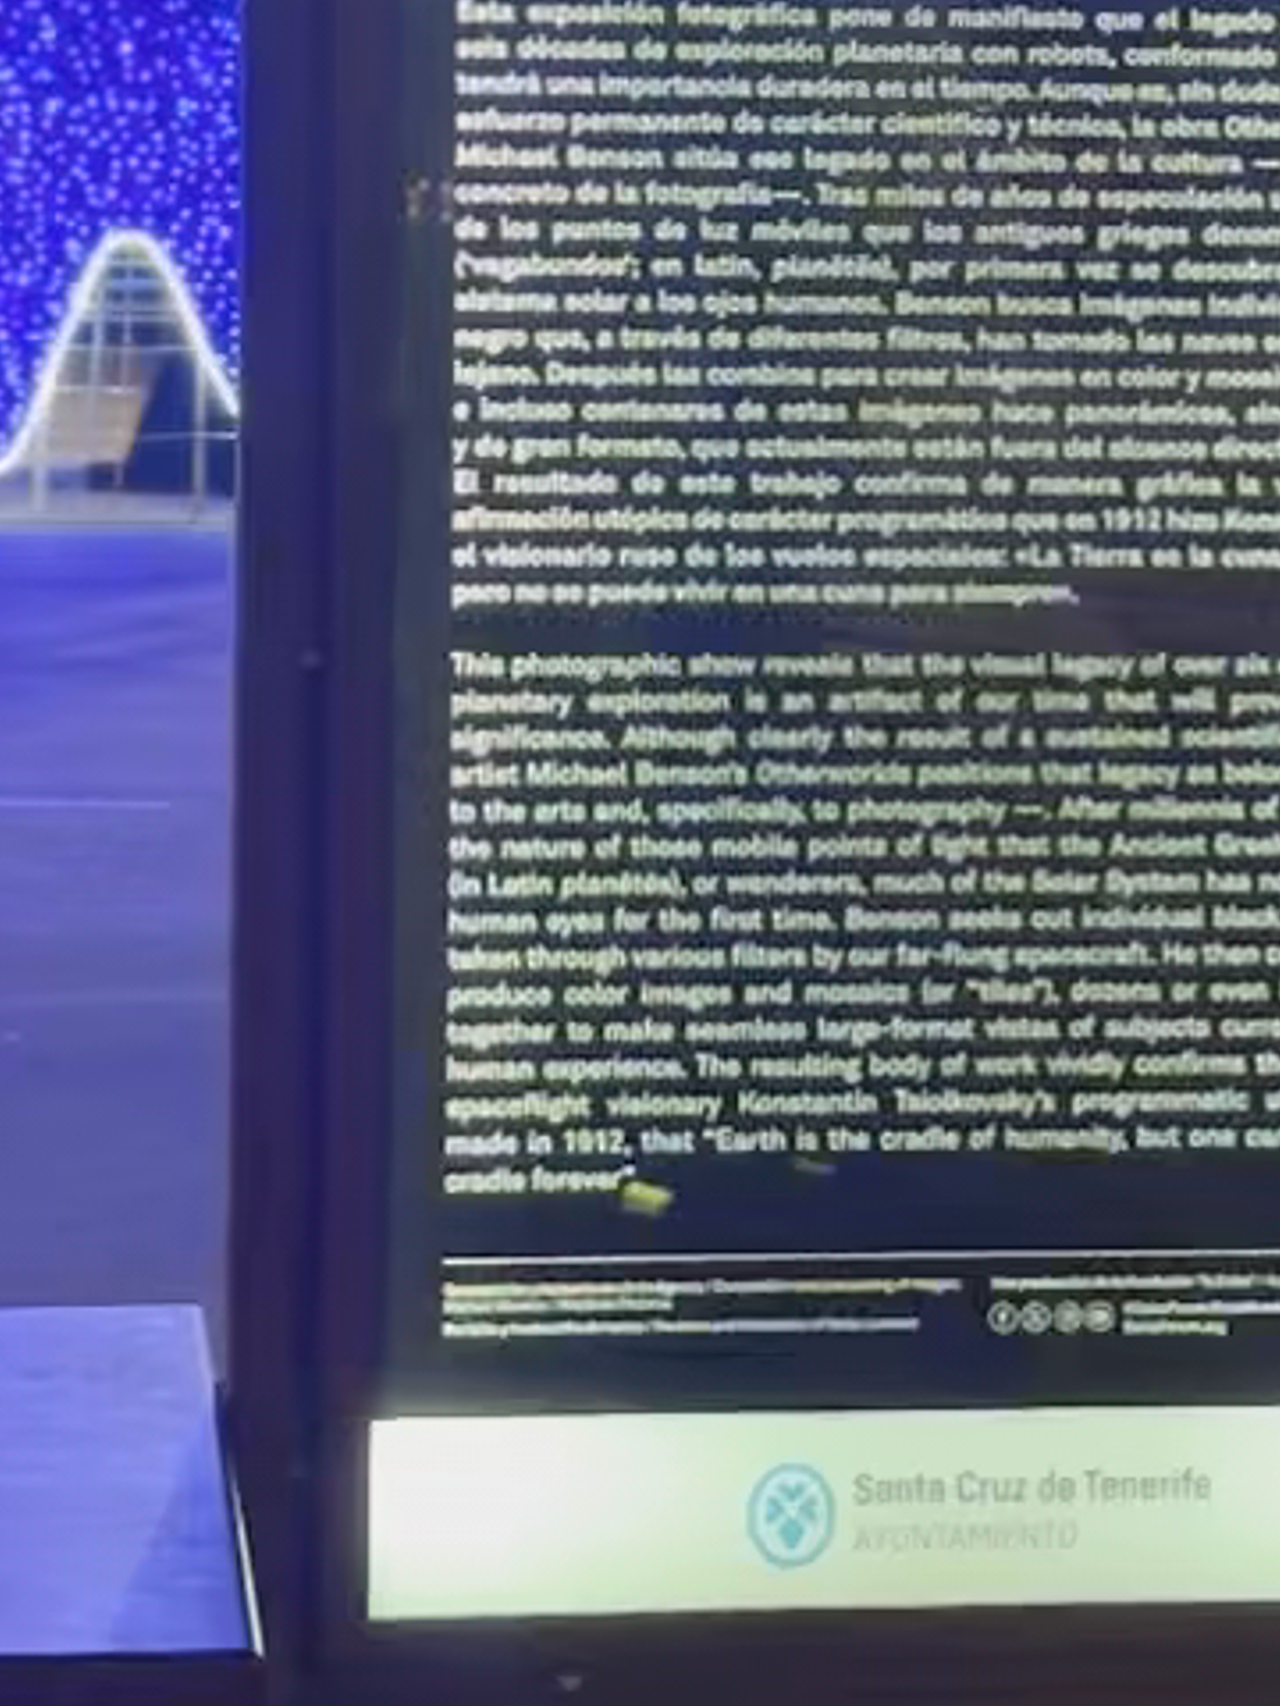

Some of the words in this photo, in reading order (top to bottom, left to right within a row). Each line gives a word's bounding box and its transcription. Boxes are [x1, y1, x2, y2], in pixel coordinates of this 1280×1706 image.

[675, 4, 817, 31] fotográfica
[828, 9, 892, 32] pone
[903, 6, 936, 28] de
[1094, 12, 1143, 34] que
[1153, 8, 1179, 30] el
[674, 40, 824, 67] exploración
[832, 41, 964, 68] planetaria
[970, 46, 1019, 64] con
[1026, 43, 1117, 69] robots,
[1122, 44, 1277, 66] conformado
[544, 79, 596, 97] una
[910, 78, 934, 99] el
[880, 113, 1001, 136] científico
[1005, 118, 1022, 140] y
[453, 146, 559, 168] Michael
[565, 147, 664, 169] Benson
[802, 149, 890, 175] legado
[613, 184, 640, 205] la
[498, 219, 540, 240] los
[550, 219, 642, 246] puntos
[750, 220, 851, 242] móviles
[862, 225, 911, 247] que
[649, 260, 683, 277] en
[908, 261, 952, 283] por
[964, 258, 1065, 284] primera
[562, 292, 629, 313] solar
[701, 292, 757, 318] ojos
[706, 328, 741, 350] de
[1116, 366, 1181, 388] color
[776, 401, 848, 423] estas
[989, 438, 1057, 459] fuera
[630, 473, 665, 494] de
[679, 473, 736, 495] este
[853, 474, 967, 495] confirma
[1102, 510, 1161, 532] 1912
[481, 545, 613, 567] visionario
[723, 546, 765, 567] los
[1070, 546, 1144, 568] Tierra
[450, 654, 505, 675] This
[509, 654, 681, 680] photographic
[861, 654, 913, 676] that
[921, 654, 965, 676] the
[1052, 654, 1133, 680] legacy
[1139, 654, 1166, 676] of
[449, 690, 573, 716] planetary
[586, 690, 731, 716] exploration
[743, 690, 767, 712] is
[781, 694, 814, 712] an
[1170, 691, 1216, 712] will
[620, 727, 736, 753] Although
[746, 727, 833, 753] clearly
[842, 727, 887, 748] the
[449, 763, 520, 785] artist
[525, 763, 628, 785] Michael
[1040, 763, 1092, 784] that
[481, 800, 527, 821] the
[532, 800, 587, 821] arts
[846, 799, 1006, 825] photography
[1058, 799, 1121, 821] After
[447, 836, 493, 858] the
[499, 836, 586, 858] nature
[593, 836, 622, 858] of
[710, 836, 798, 858] mobile
[806, 836, 888, 862] points
[1057, 835, 1101, 857] the
[486, 873, 554, 894] Latin
[691, 876, 719, 894] or
[872, 872, 944, 894] much
[950, 872, 977, 894] of
[1104, 872, 1200, 898] System
[1205, 872, 1252, 893] has
[446, 909, 538, 931] human
[544, 913, 605, 935] eyes
[612, 909, 649, 931] for
[657, 909, 701, 931] the
[709, 909, 763, 931] first
[771, 909, 835, 930] time.
[1029, 908, 1073, 930] out
[524, 946, 627, 972] through
[630, 945, 726, 967] various
[730, 945, 807, 967] filters
[811, 945, 843, 971] by
[847, 949, 889, 967] our
[562, 982, 629, 1004] color
[638, 982, 733, 1008] images
[743, 982, 793, 1003] and
[1170, 984, 1198, 1002] or
[565, 1020, 594, 1041] to
[602, 1019, 675, 1041] make
[445, 1056, 536, 1078] human
[541, 1056, 687, 1083] experience.
[695, 1056, 742, 1077] The
[748, 1055, 862, 1082] resulting
[868, 1055, 931, 1081] body
[974, 1054, 1037, 1076] work
[605, 1092, 722, 1119] visionary
[737, 1092, 878, 1114] Konstantin
[1070, 1090, 1250, 1117] programmatic
[443, 1131, 519, 1153] made
[525, 1131, 553, 1153] in
[563, 1130, 632, 1157] 1912,
[639, 1130, 694, 1152] that
[794, 1129, 818, 1151] is
[826, 1129, 871, 1151] the
[879, 1129, 960, 1151] cradle
[1135, 1128, 1180, 1149] but
[1187, 1131, 1237, 1149] one
[443, 1170, 530, 1192] cradle
[851, 1472, 947, 1506] Santa
[955, 1469, 1028, 1504] Cruz
[1037, 1468, 1077, 1503] de
[1083, 1466, 1213, 1502] Tenerife
